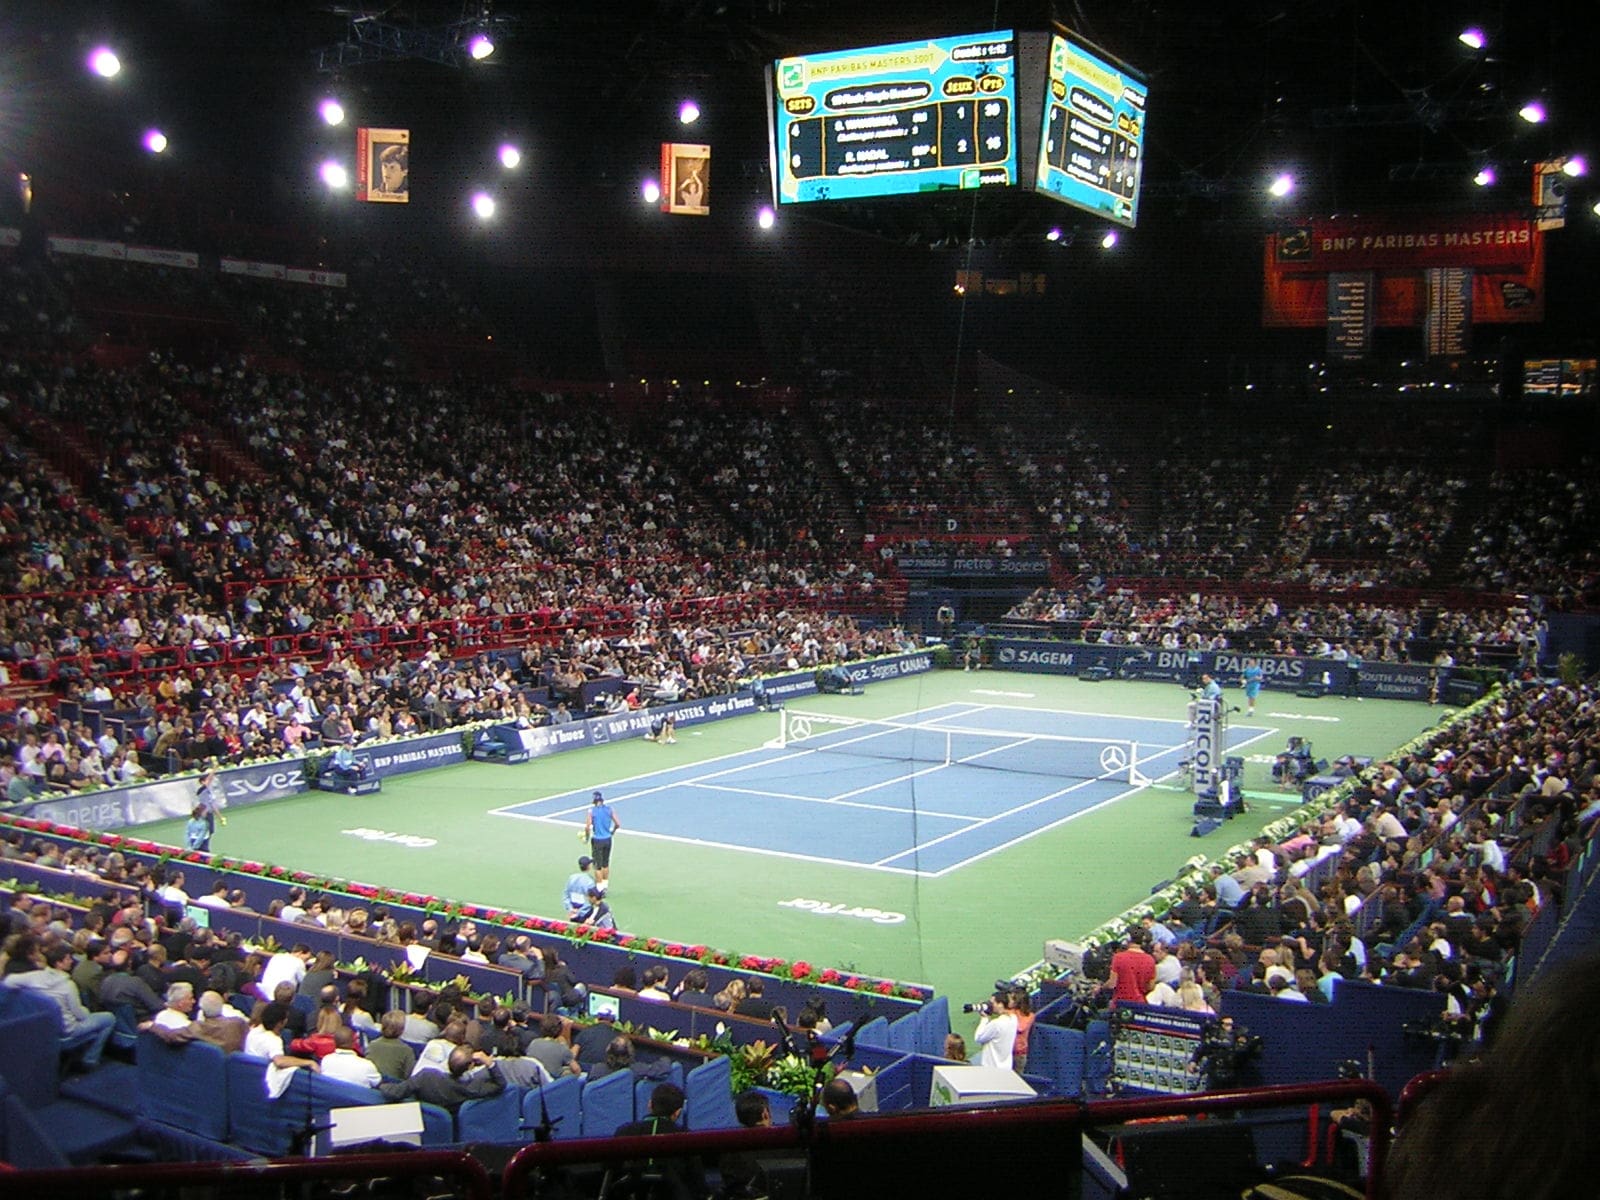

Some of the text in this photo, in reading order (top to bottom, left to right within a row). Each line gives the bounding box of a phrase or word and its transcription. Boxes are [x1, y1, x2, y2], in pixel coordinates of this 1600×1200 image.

[945, 81, 973, 93] JEUX
[982, 78, 1002, 90] PTS
[957, 106, 965, 119] 1
[957, 139, 967, 153] 2
[1322, 229, 1531, 252] BNP PARIBAS MASTERS
[946, 518, 957, 531] D
[953, 558, 994, 570] metro
[1000, 558, 1046, 573] Sogeres
[899, 656, 931, 673] CANAL+
[1017, 650, 1074, 666] SAGEM
[1157, 652, 1189, 669] BN
[1357, 670, 1393, 683] SOUTH
[608, 719, 628, 734] BNP
[1195, 709, 1211, 786] RICOH
[374, 743, 463, 768] BNP PARIBAS MASTERS
